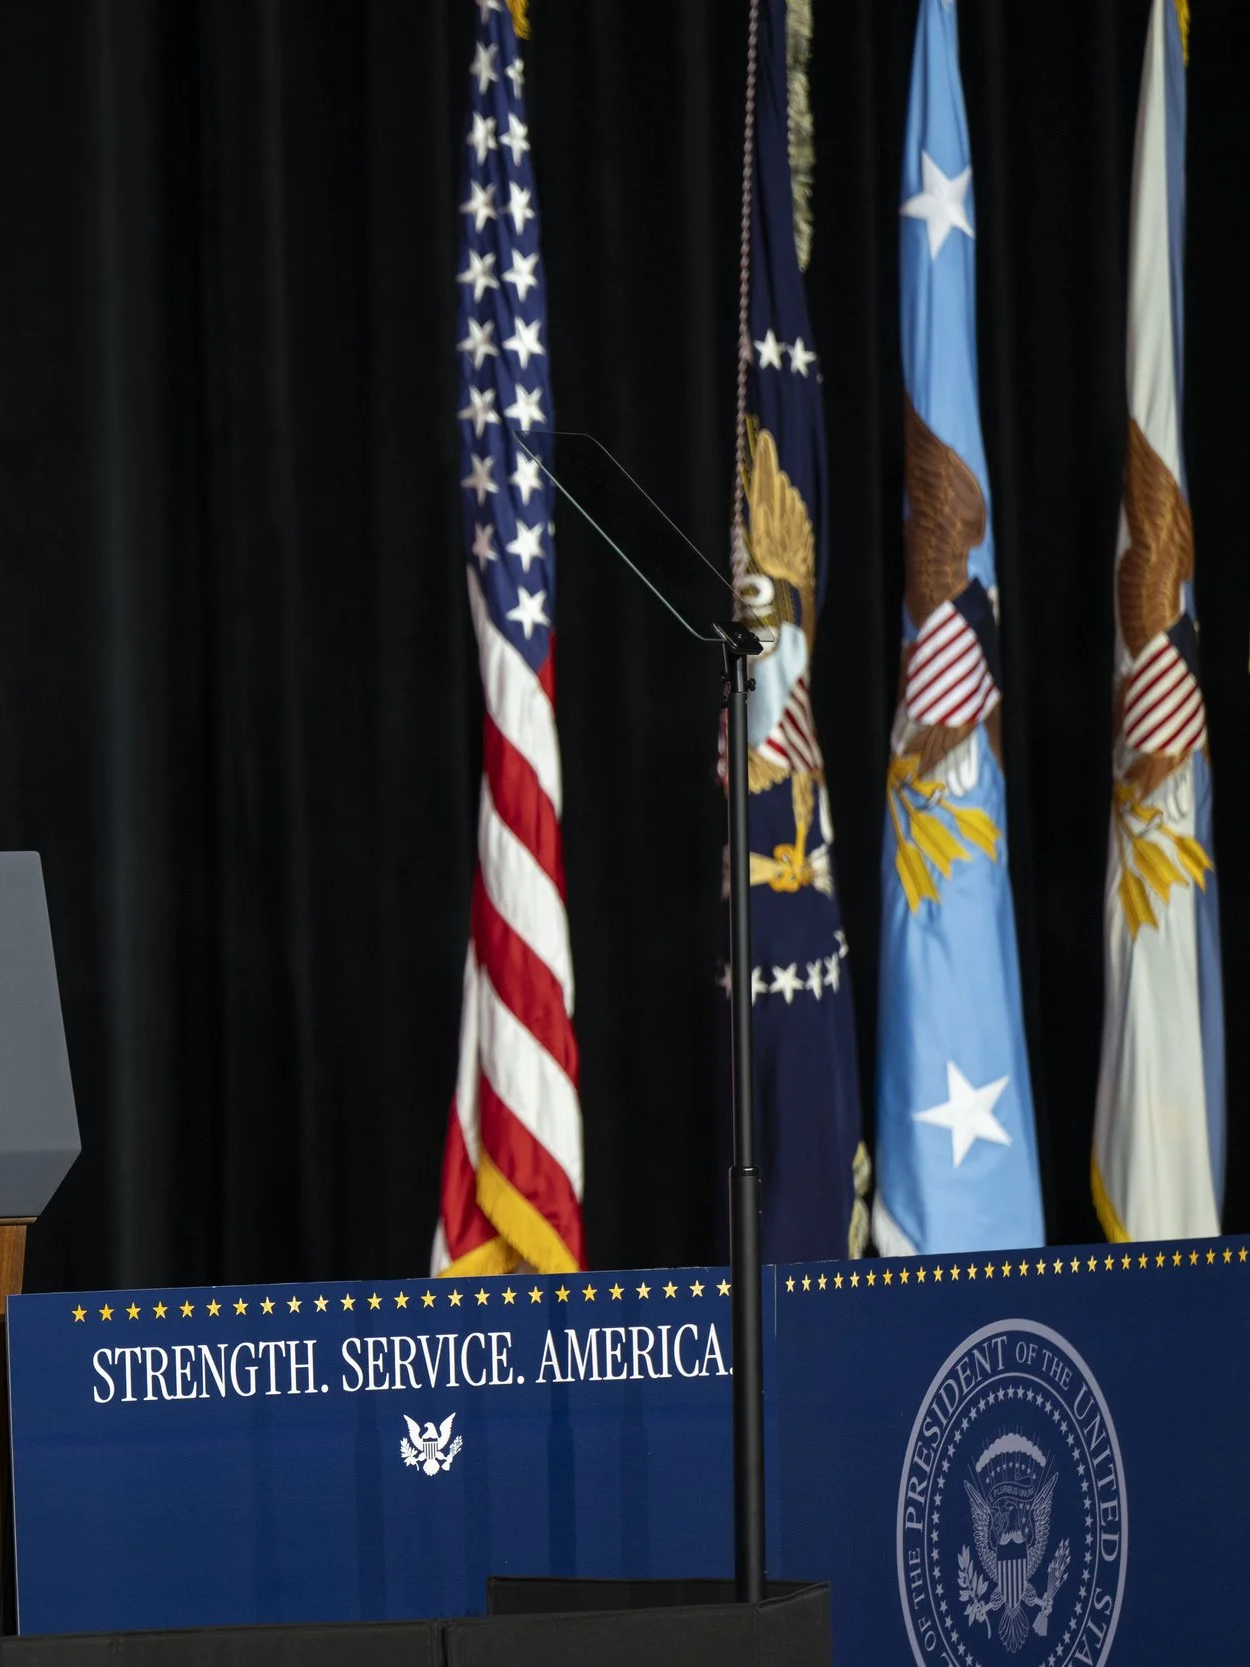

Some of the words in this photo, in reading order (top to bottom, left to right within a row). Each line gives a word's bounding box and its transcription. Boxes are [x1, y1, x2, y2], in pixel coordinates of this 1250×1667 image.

[92, 1339, 329, 1404] STRENGTH.
[341, 1331, 525, 1392] SERVICE.
[1015, 1340, 1039, 1366] OF
[1041, 1348, 1073, 1392] THE
[905, 1335, 1008, 1533] PRESIDENT
[1072, 1382, 1120, 1563] UNITED
[908, 1547, 925, 1610] THE
[917, 1616, 937, 1652] OF
